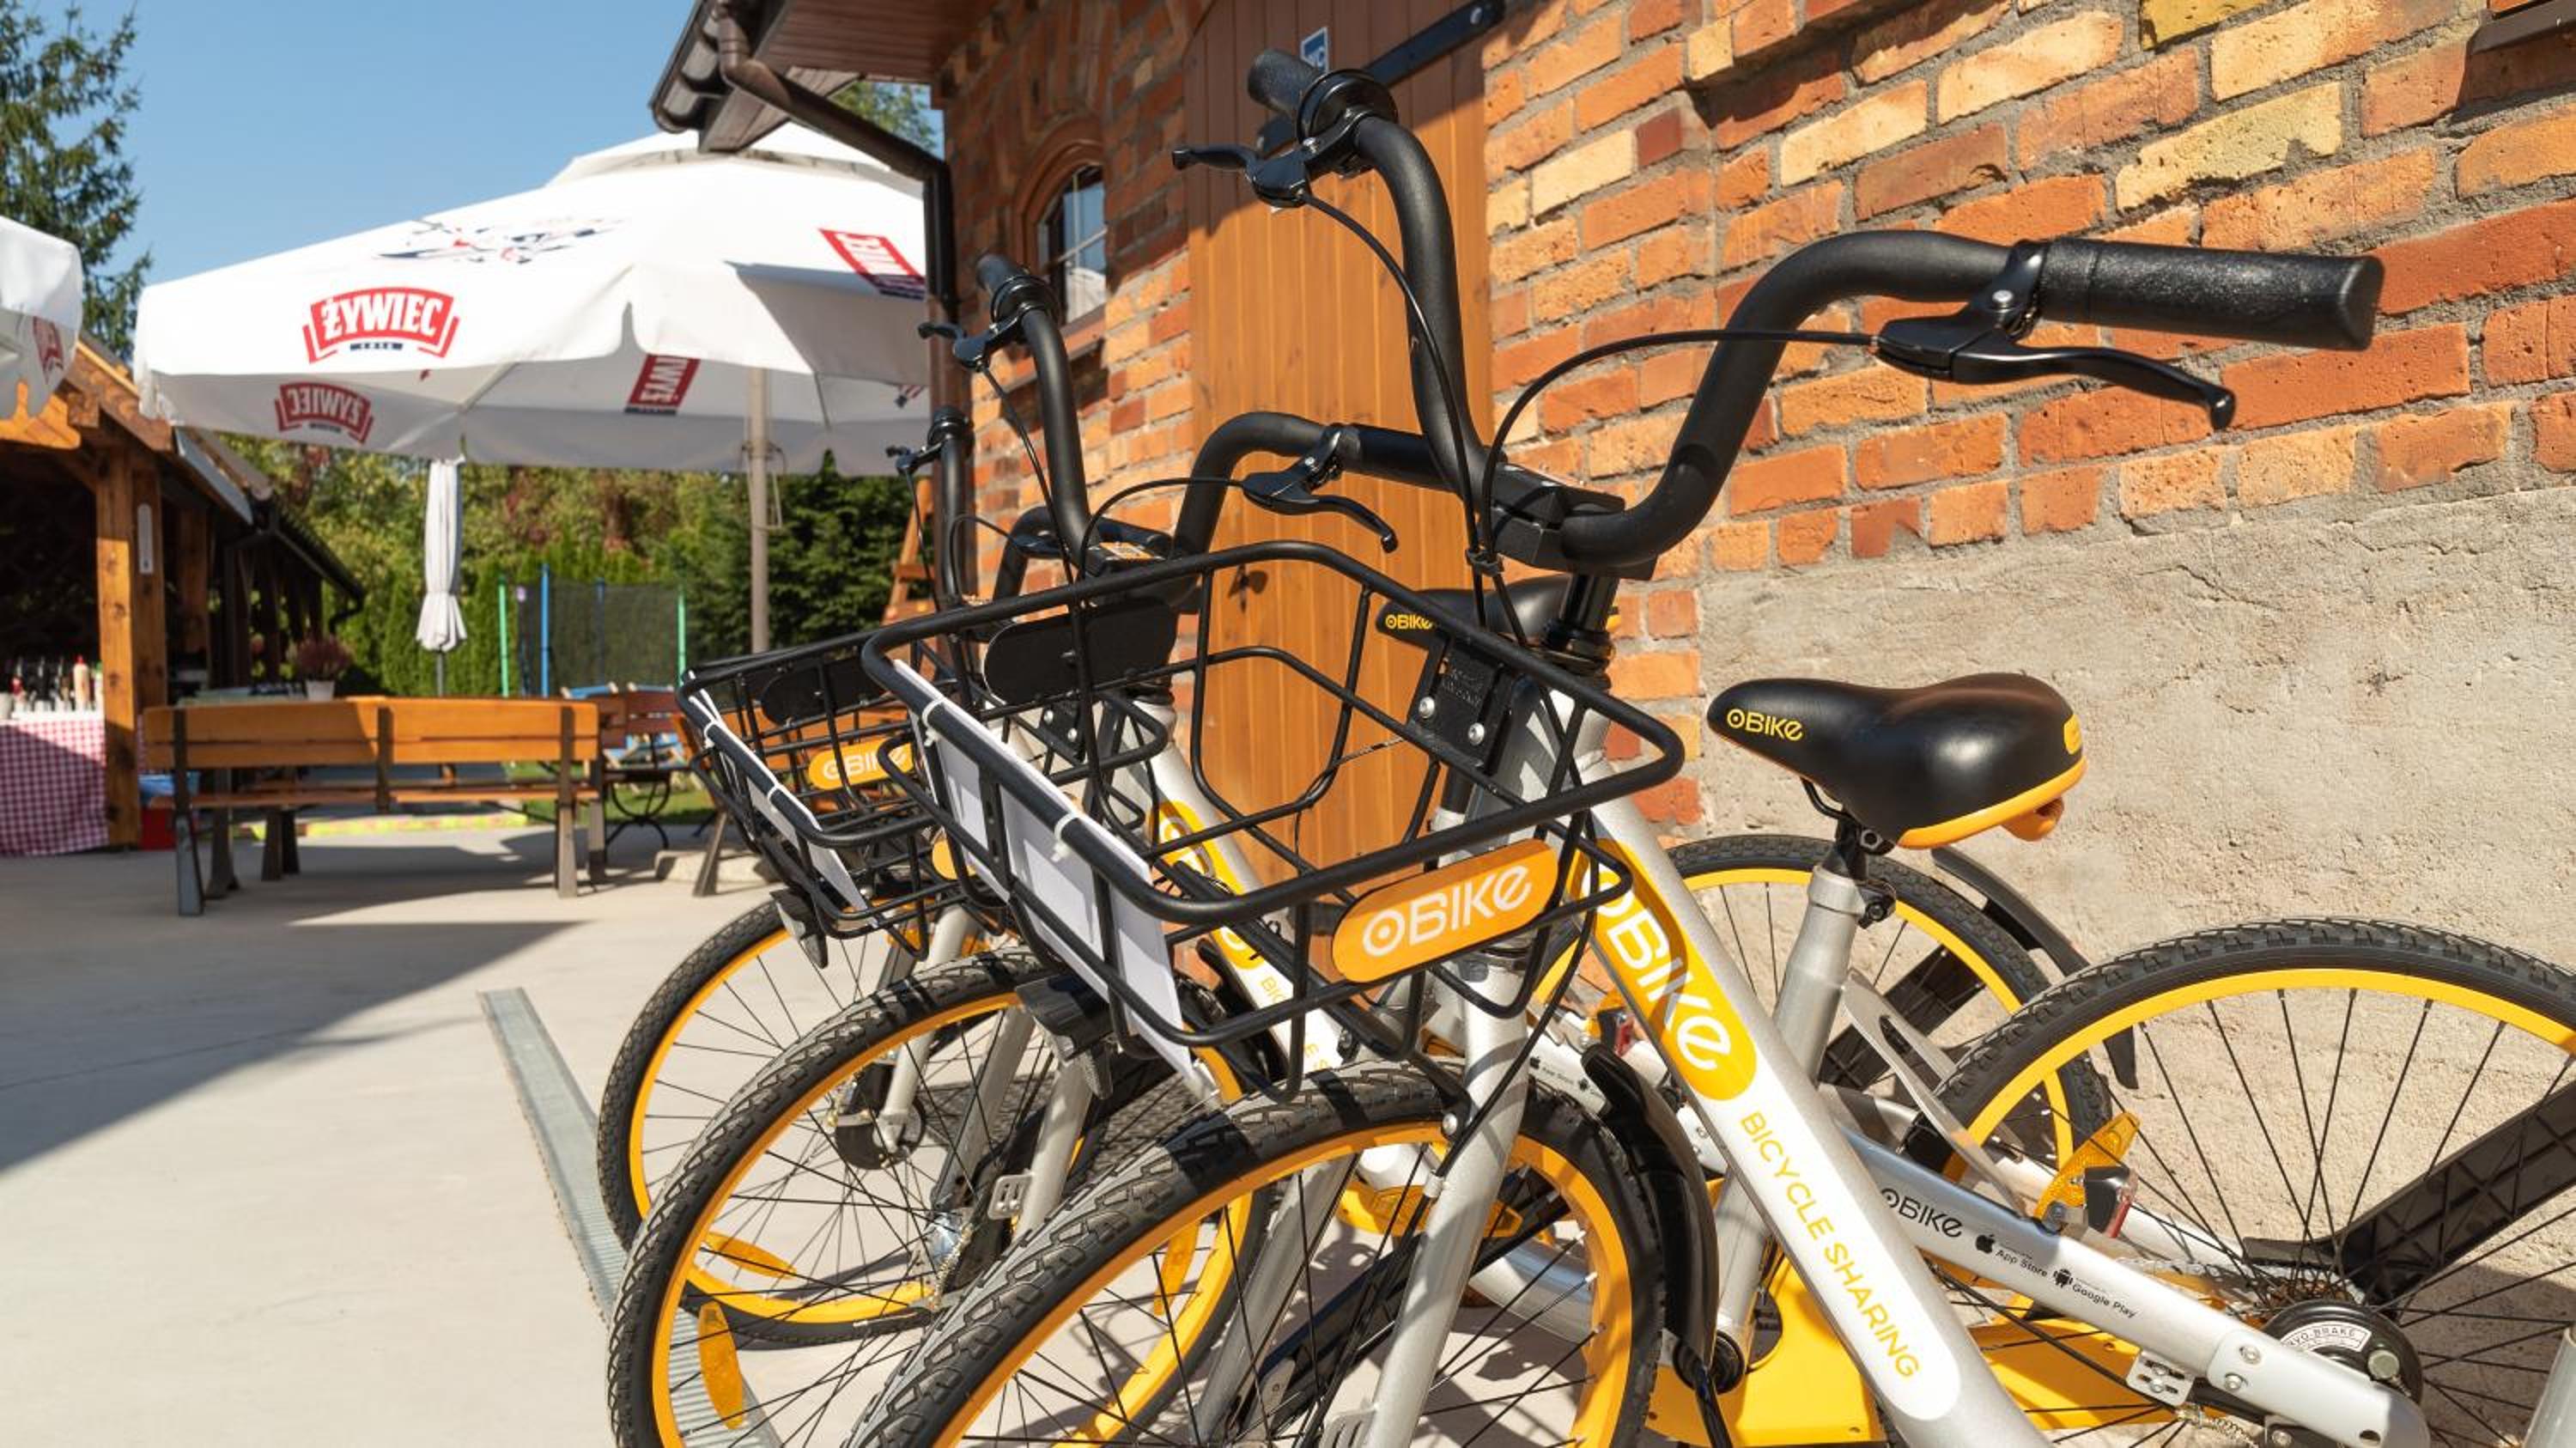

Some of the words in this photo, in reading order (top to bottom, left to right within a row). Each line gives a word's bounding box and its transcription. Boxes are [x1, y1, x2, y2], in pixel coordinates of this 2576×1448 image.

[320, 293, 443, 341] ŻYWIEC
[1740, 1111, 1835, 1240] BICYCLE
[1824, 1242, 1920, 1377] SHARING
[1996, 1250, 2018, 1264] App
[2020, 1258, 2048, 1277] Store
[2072, 1284, 2110, 1305] Google
[2112, 1301, 2138, 1318] Play
